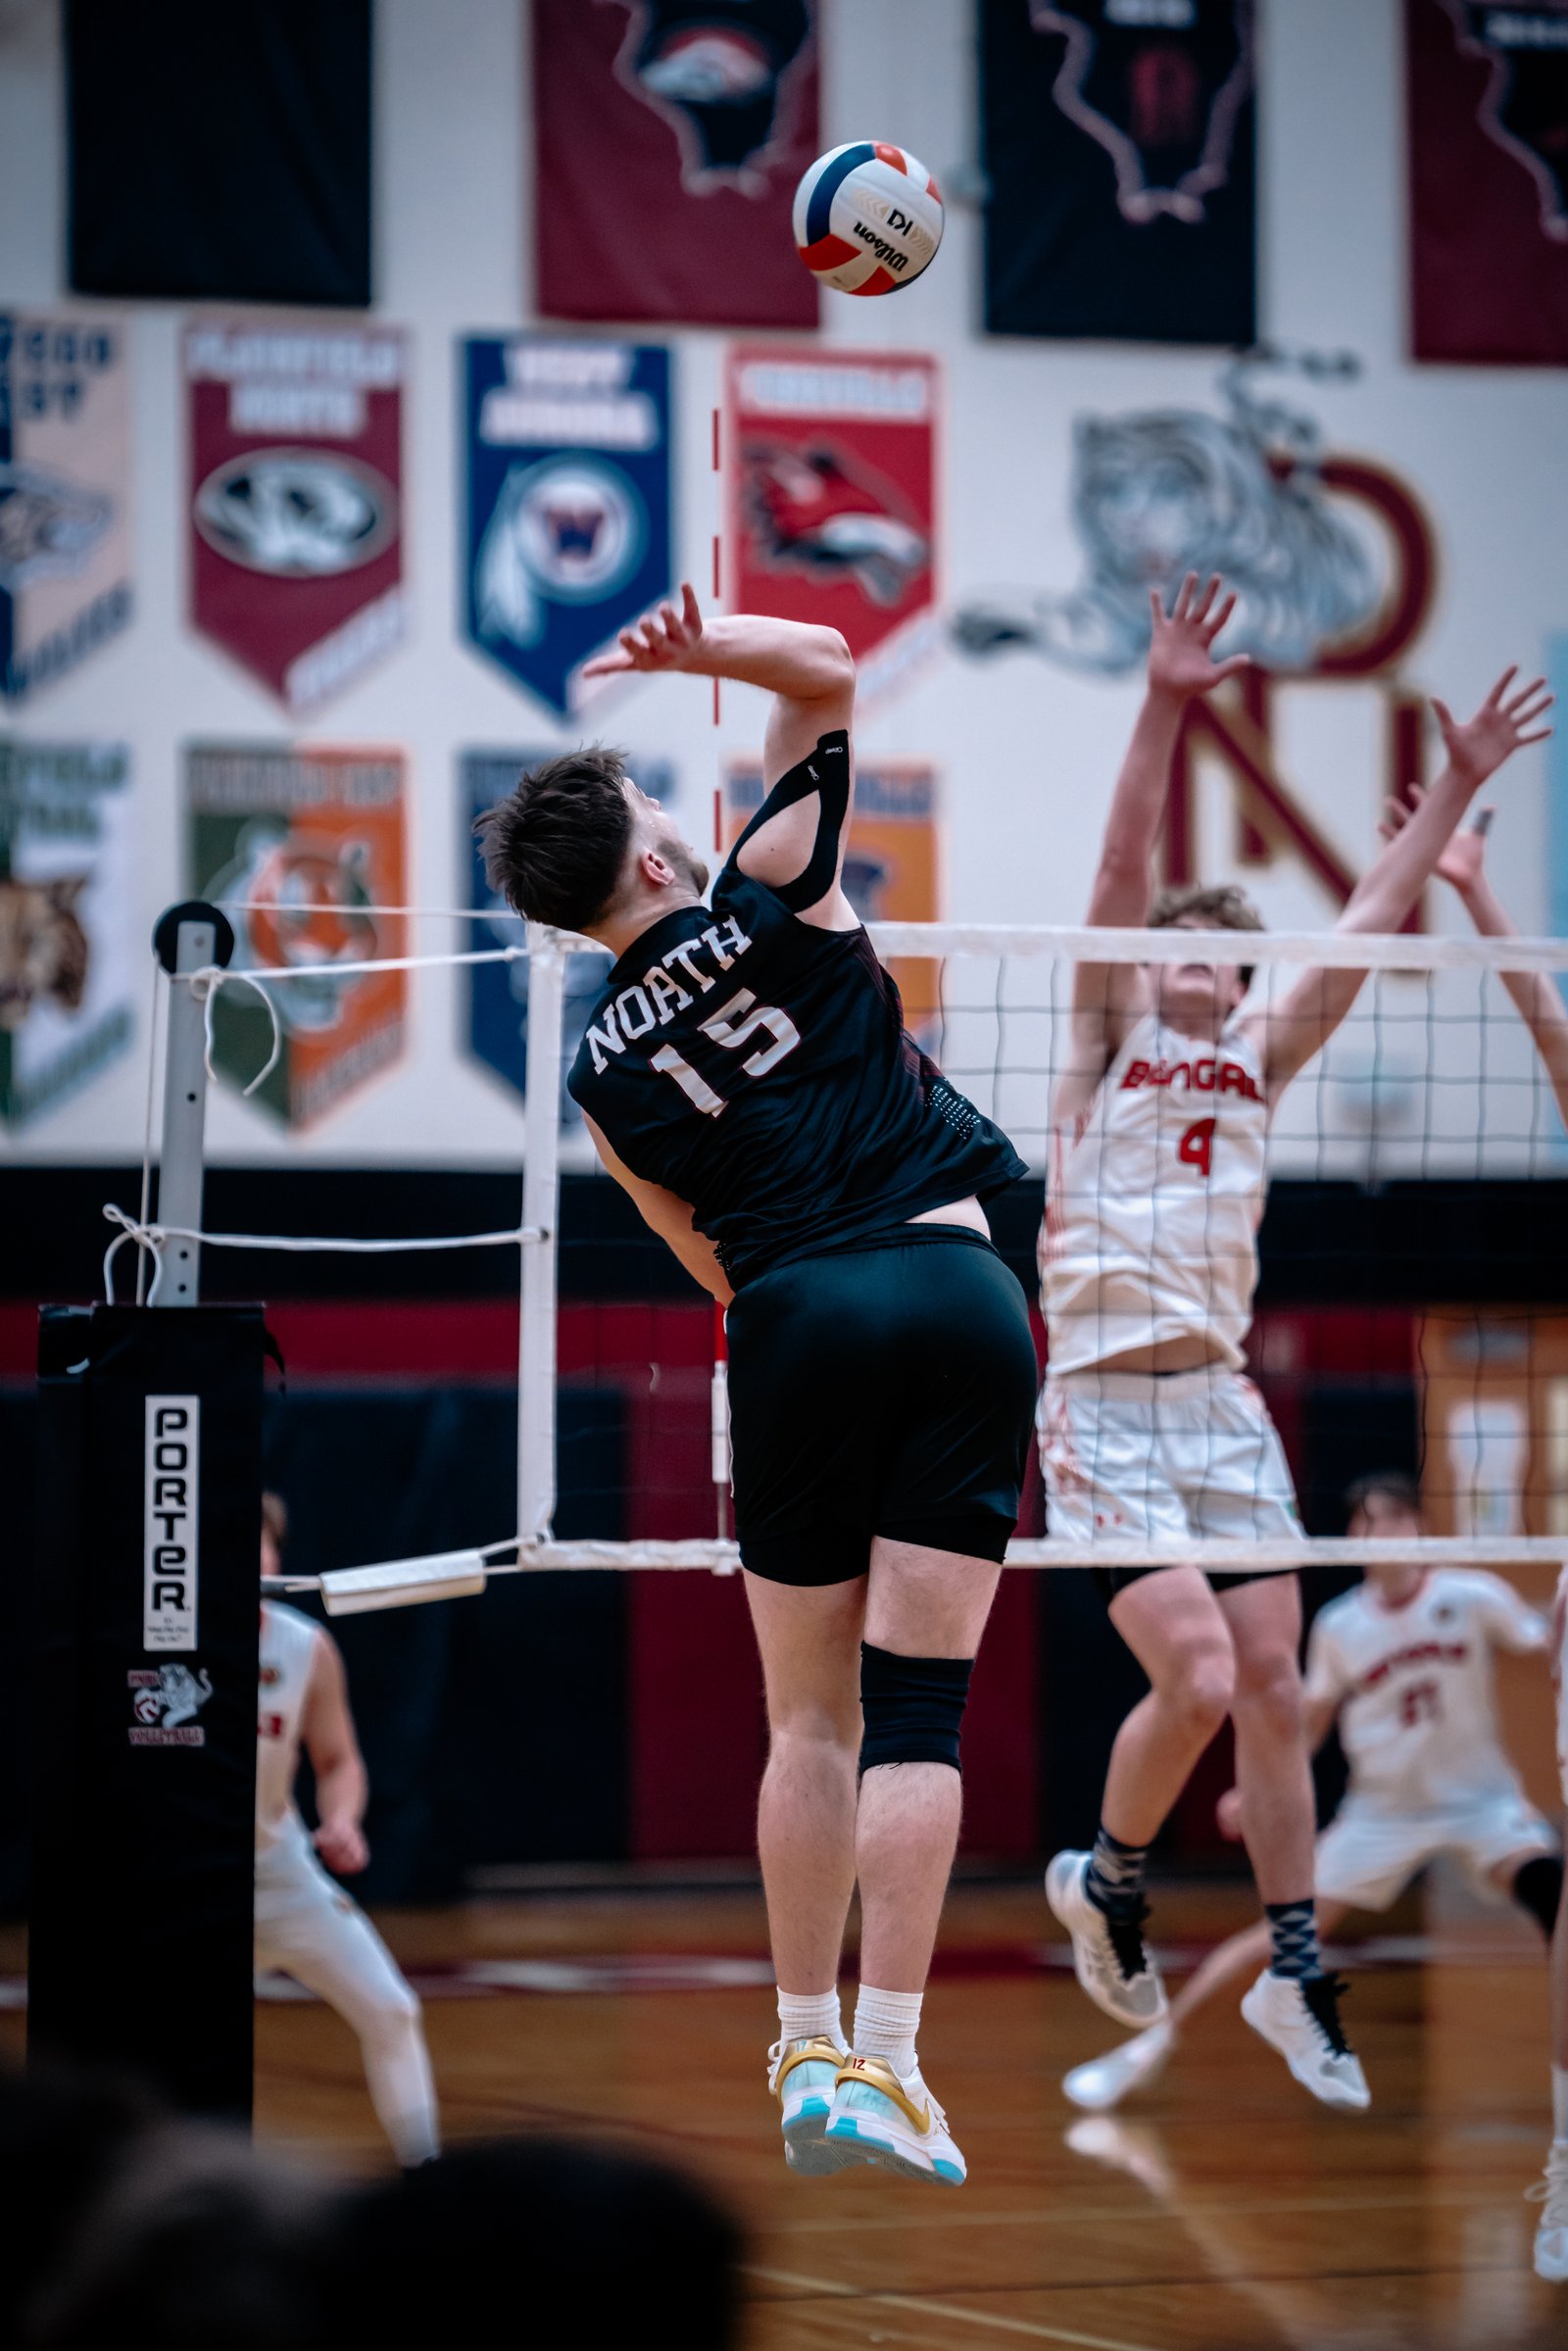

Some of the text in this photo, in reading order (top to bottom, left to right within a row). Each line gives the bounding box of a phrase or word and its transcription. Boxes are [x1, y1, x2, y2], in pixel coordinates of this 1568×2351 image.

[853, 220, 908, 271] Wilson
[586, 914, 753, 1075] NORTH
[648, 986, 802, 1118] 15
[1179, 1117, 1217, 1177] 4
